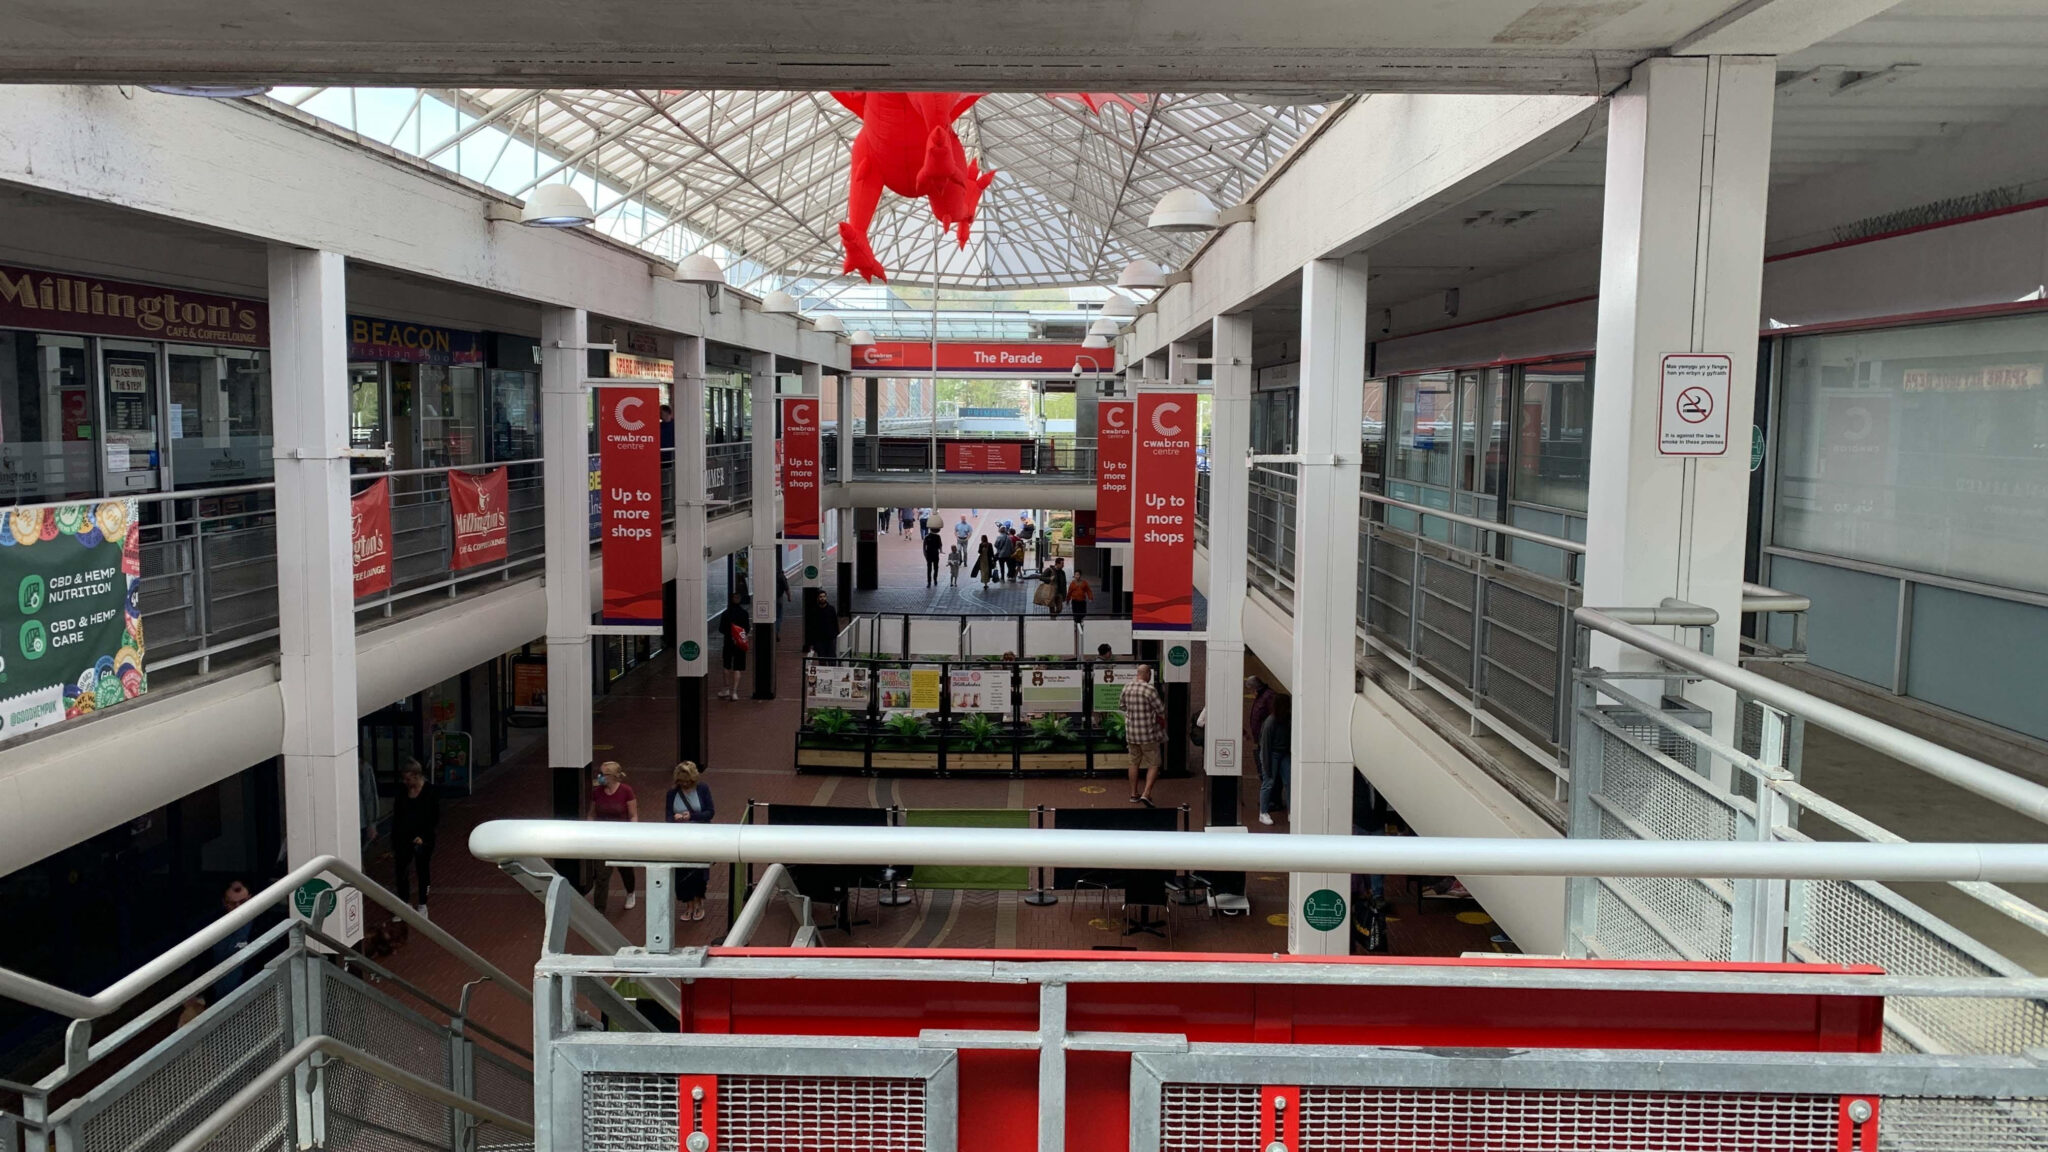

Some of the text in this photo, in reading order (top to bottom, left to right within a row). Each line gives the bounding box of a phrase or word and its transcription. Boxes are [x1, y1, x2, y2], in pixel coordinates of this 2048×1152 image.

[0, 270, 257, 331] Millington's
[189, 328, 196, 338] &
[352, 319, 450, 352] BEACON
[973, 351, 1042, 364] The Parade
[110, 366, 131, 377] PLEASE
[606, 432, 654, 444] cwmbran
[1143, 439, 1190, 448] cwmbran
[616, 442, 645, 450] centre
[1152, 448, 1180, 456] centre
[789, 458, 814, 469] Up to
[1103, 461, 1127, 471] Up to
[790, 470, 812, 478] more
[789, 478, 814, 488] shops
[1102, 482, 1127, 492] shops
[611, 488, 652, 505] Up to
[1145, 493, 1185, 510] Up to
[614, 508, 650, 520] more
[1146, 514, 1183, 525] more
[611, 525, 652, 541] shops
[1144, 531, 1184, 546] shops
[352, 528, 384, 567] gton's
[50, 567, 116, 590] CBD & HEMP
[49, 582, 112, 603] NUTRITION
[50, 609, 116, 634] CBD & HEMP
[52, 630, 84, 648] CARE
[10, 700, 57, 727] @GOODHEMPUK
